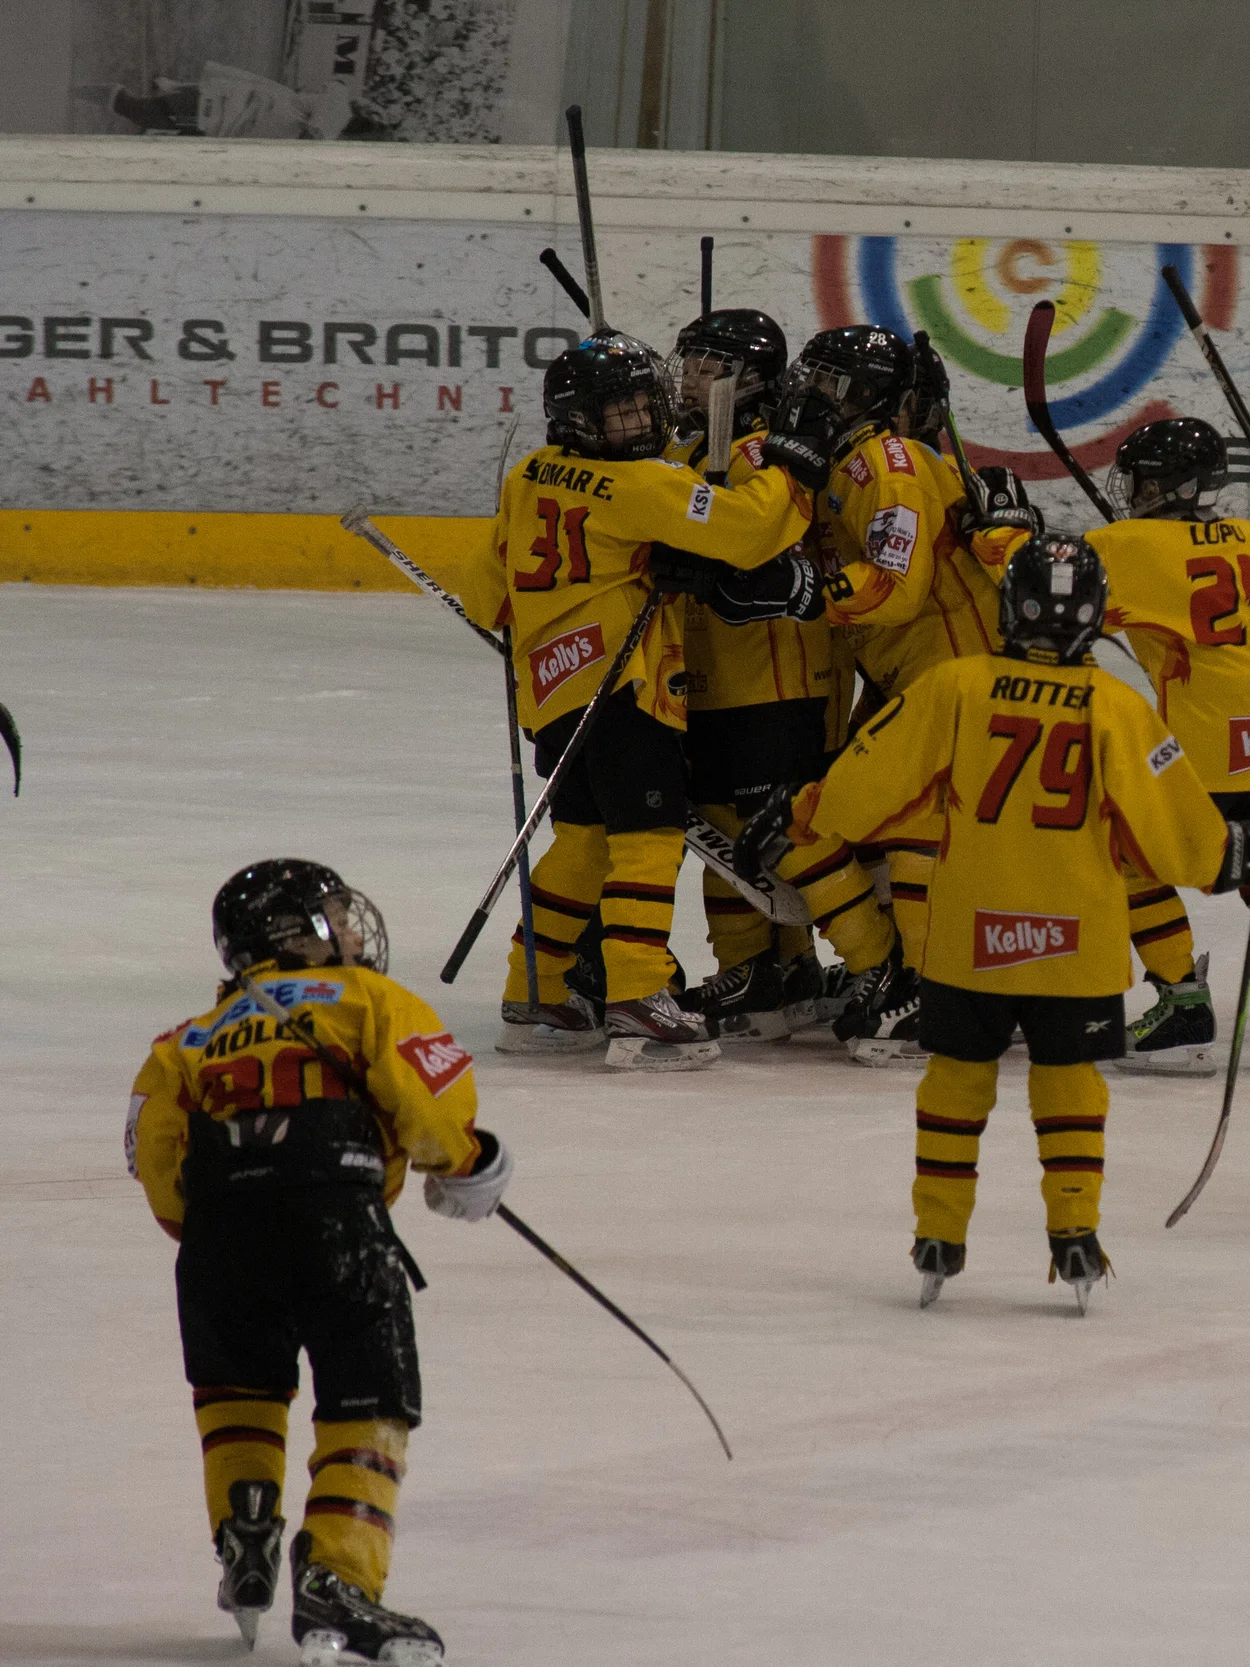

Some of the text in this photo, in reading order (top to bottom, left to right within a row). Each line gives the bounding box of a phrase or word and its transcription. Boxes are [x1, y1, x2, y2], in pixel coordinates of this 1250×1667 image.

[0, 315, 580, 369] GER & BRAITO
[869, 331, 887, 345] 28
[592, 476, 615, 501] E.
[514, 497, 590, 592] 31
[1190, 523, 1246, 546] LUPU
[795, 559, 815, 616] BAUER
[537, 635, 594, 687] Kelly's
[975, 713, 1096, 831] 79
[984, 920, 1065, 957] Kelly's
